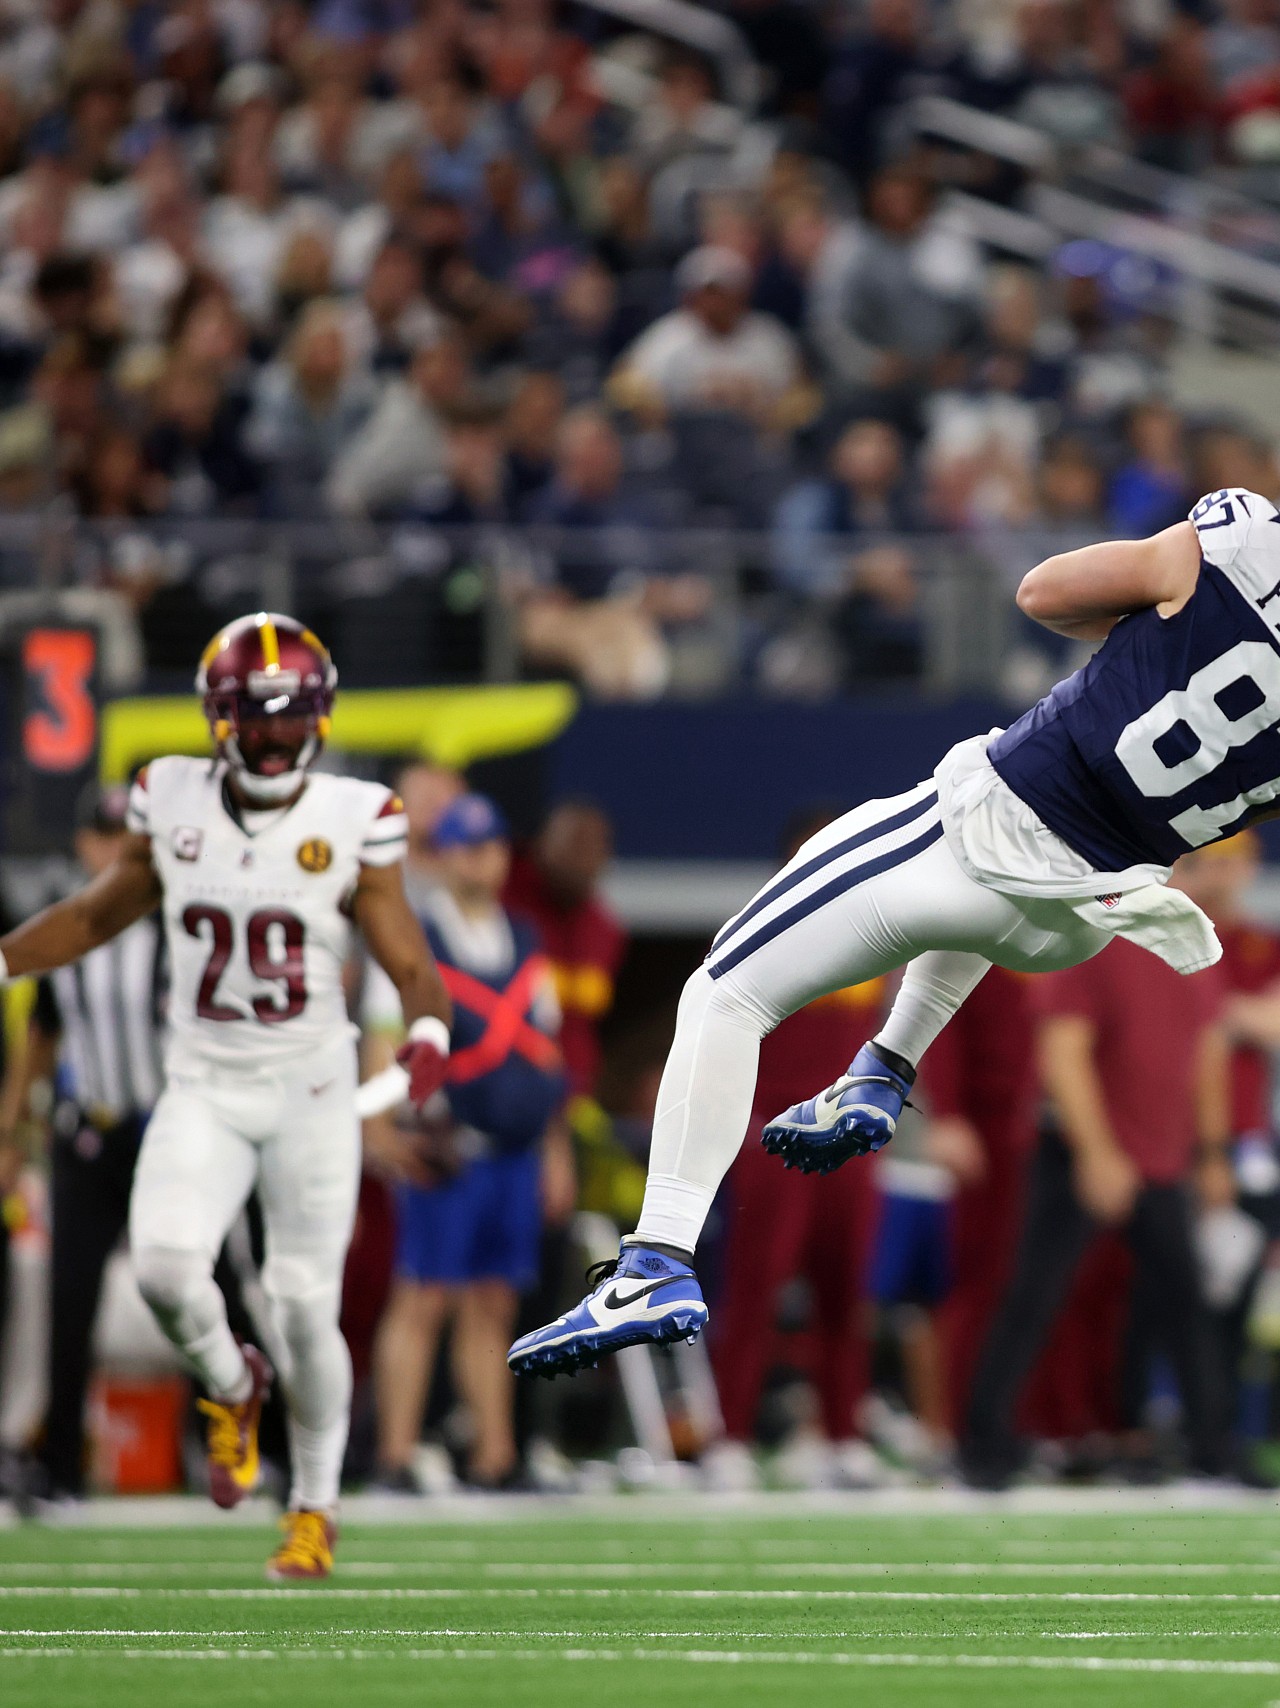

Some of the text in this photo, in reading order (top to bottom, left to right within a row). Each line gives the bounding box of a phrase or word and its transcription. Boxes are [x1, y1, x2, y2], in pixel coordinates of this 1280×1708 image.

[1192, 489, 1236, 531] 87
[24, 630, 95, 772] 3
[182, 903, 306, 1024] 29
